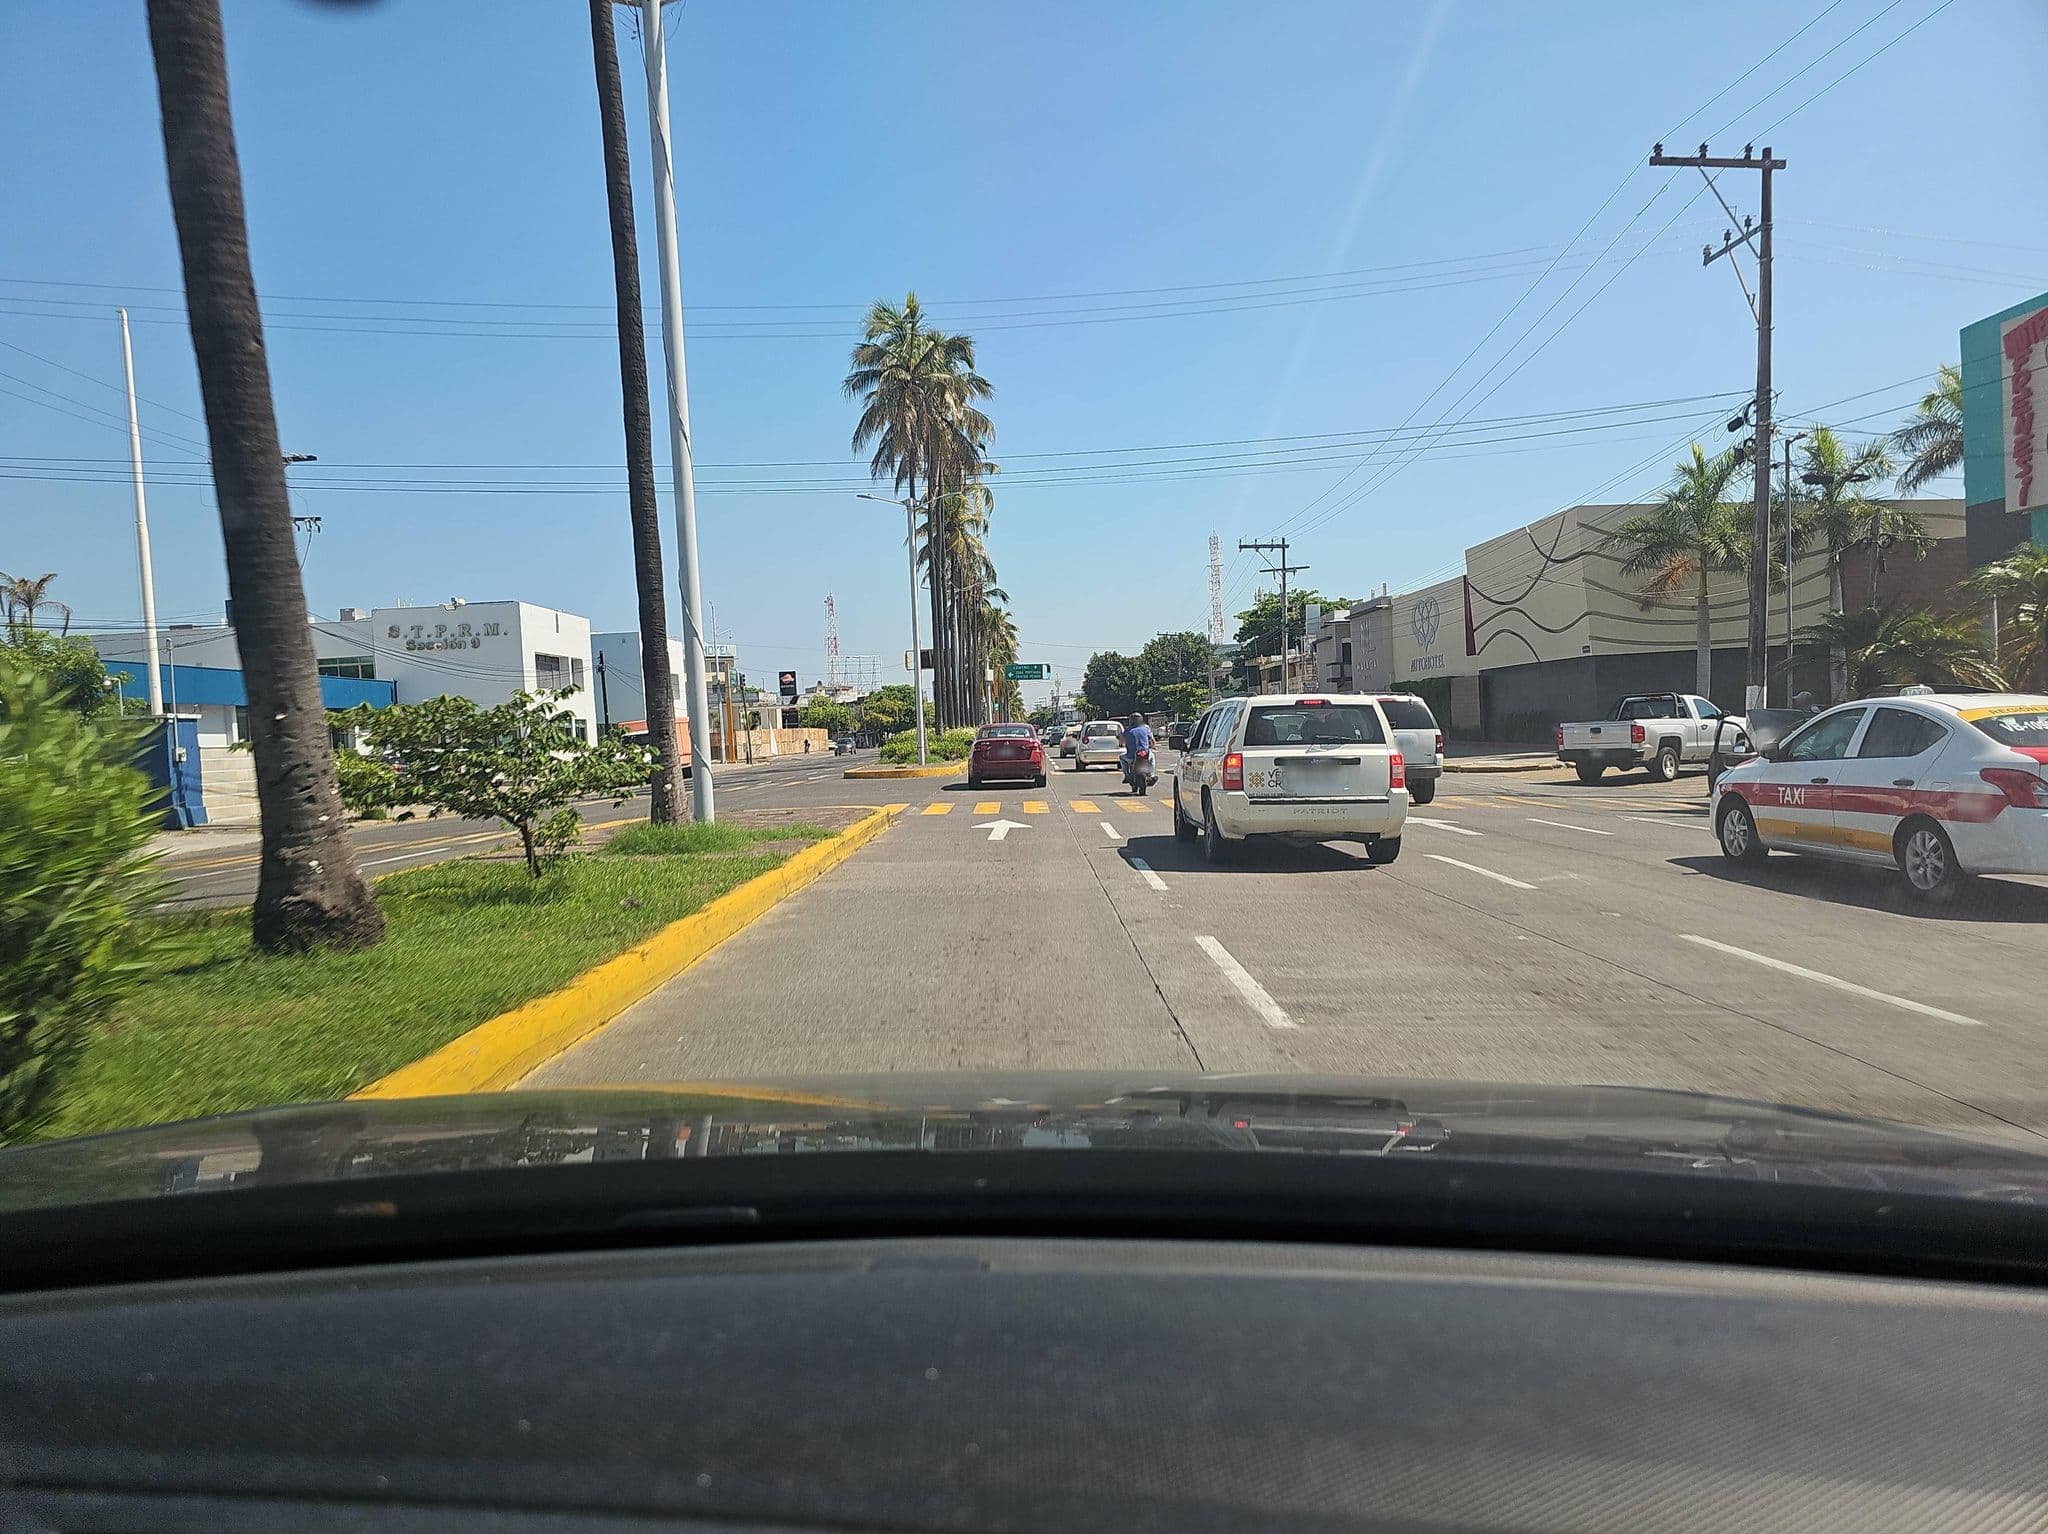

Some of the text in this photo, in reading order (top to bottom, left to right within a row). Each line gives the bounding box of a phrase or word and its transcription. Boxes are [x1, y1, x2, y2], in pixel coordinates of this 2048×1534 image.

[387, 623, 509, 639] S.T.P.R.M.
[470, 637, 481, 649] 9
[1777, 787, 1805, 805] TAXI
